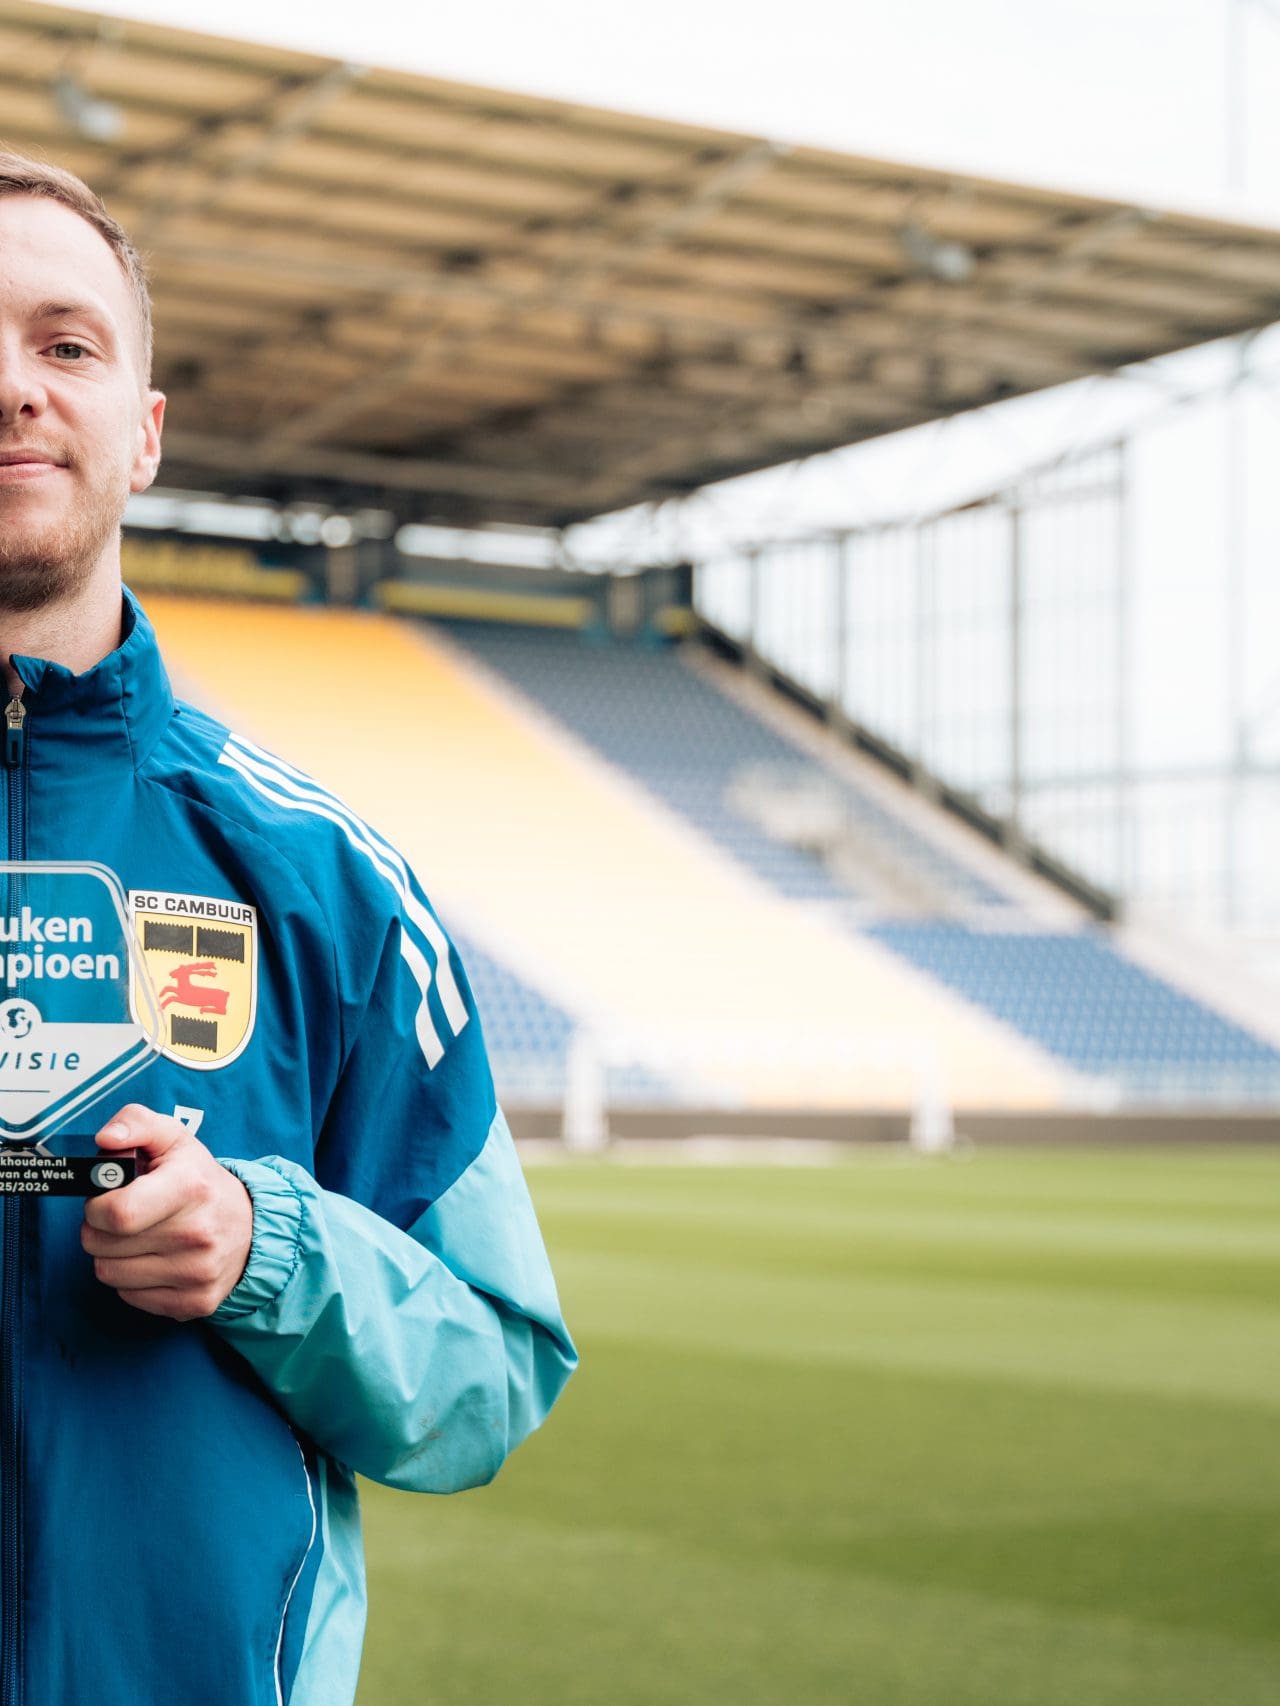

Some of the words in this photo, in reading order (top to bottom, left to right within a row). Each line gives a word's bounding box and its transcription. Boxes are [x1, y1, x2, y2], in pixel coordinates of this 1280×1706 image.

[134, 895, 158, 910] SC
[165, 897, 253, 923] CAMBUUR
[24, 1168, 40, 1180] de
[42, 1169, 75, 1180] Week
